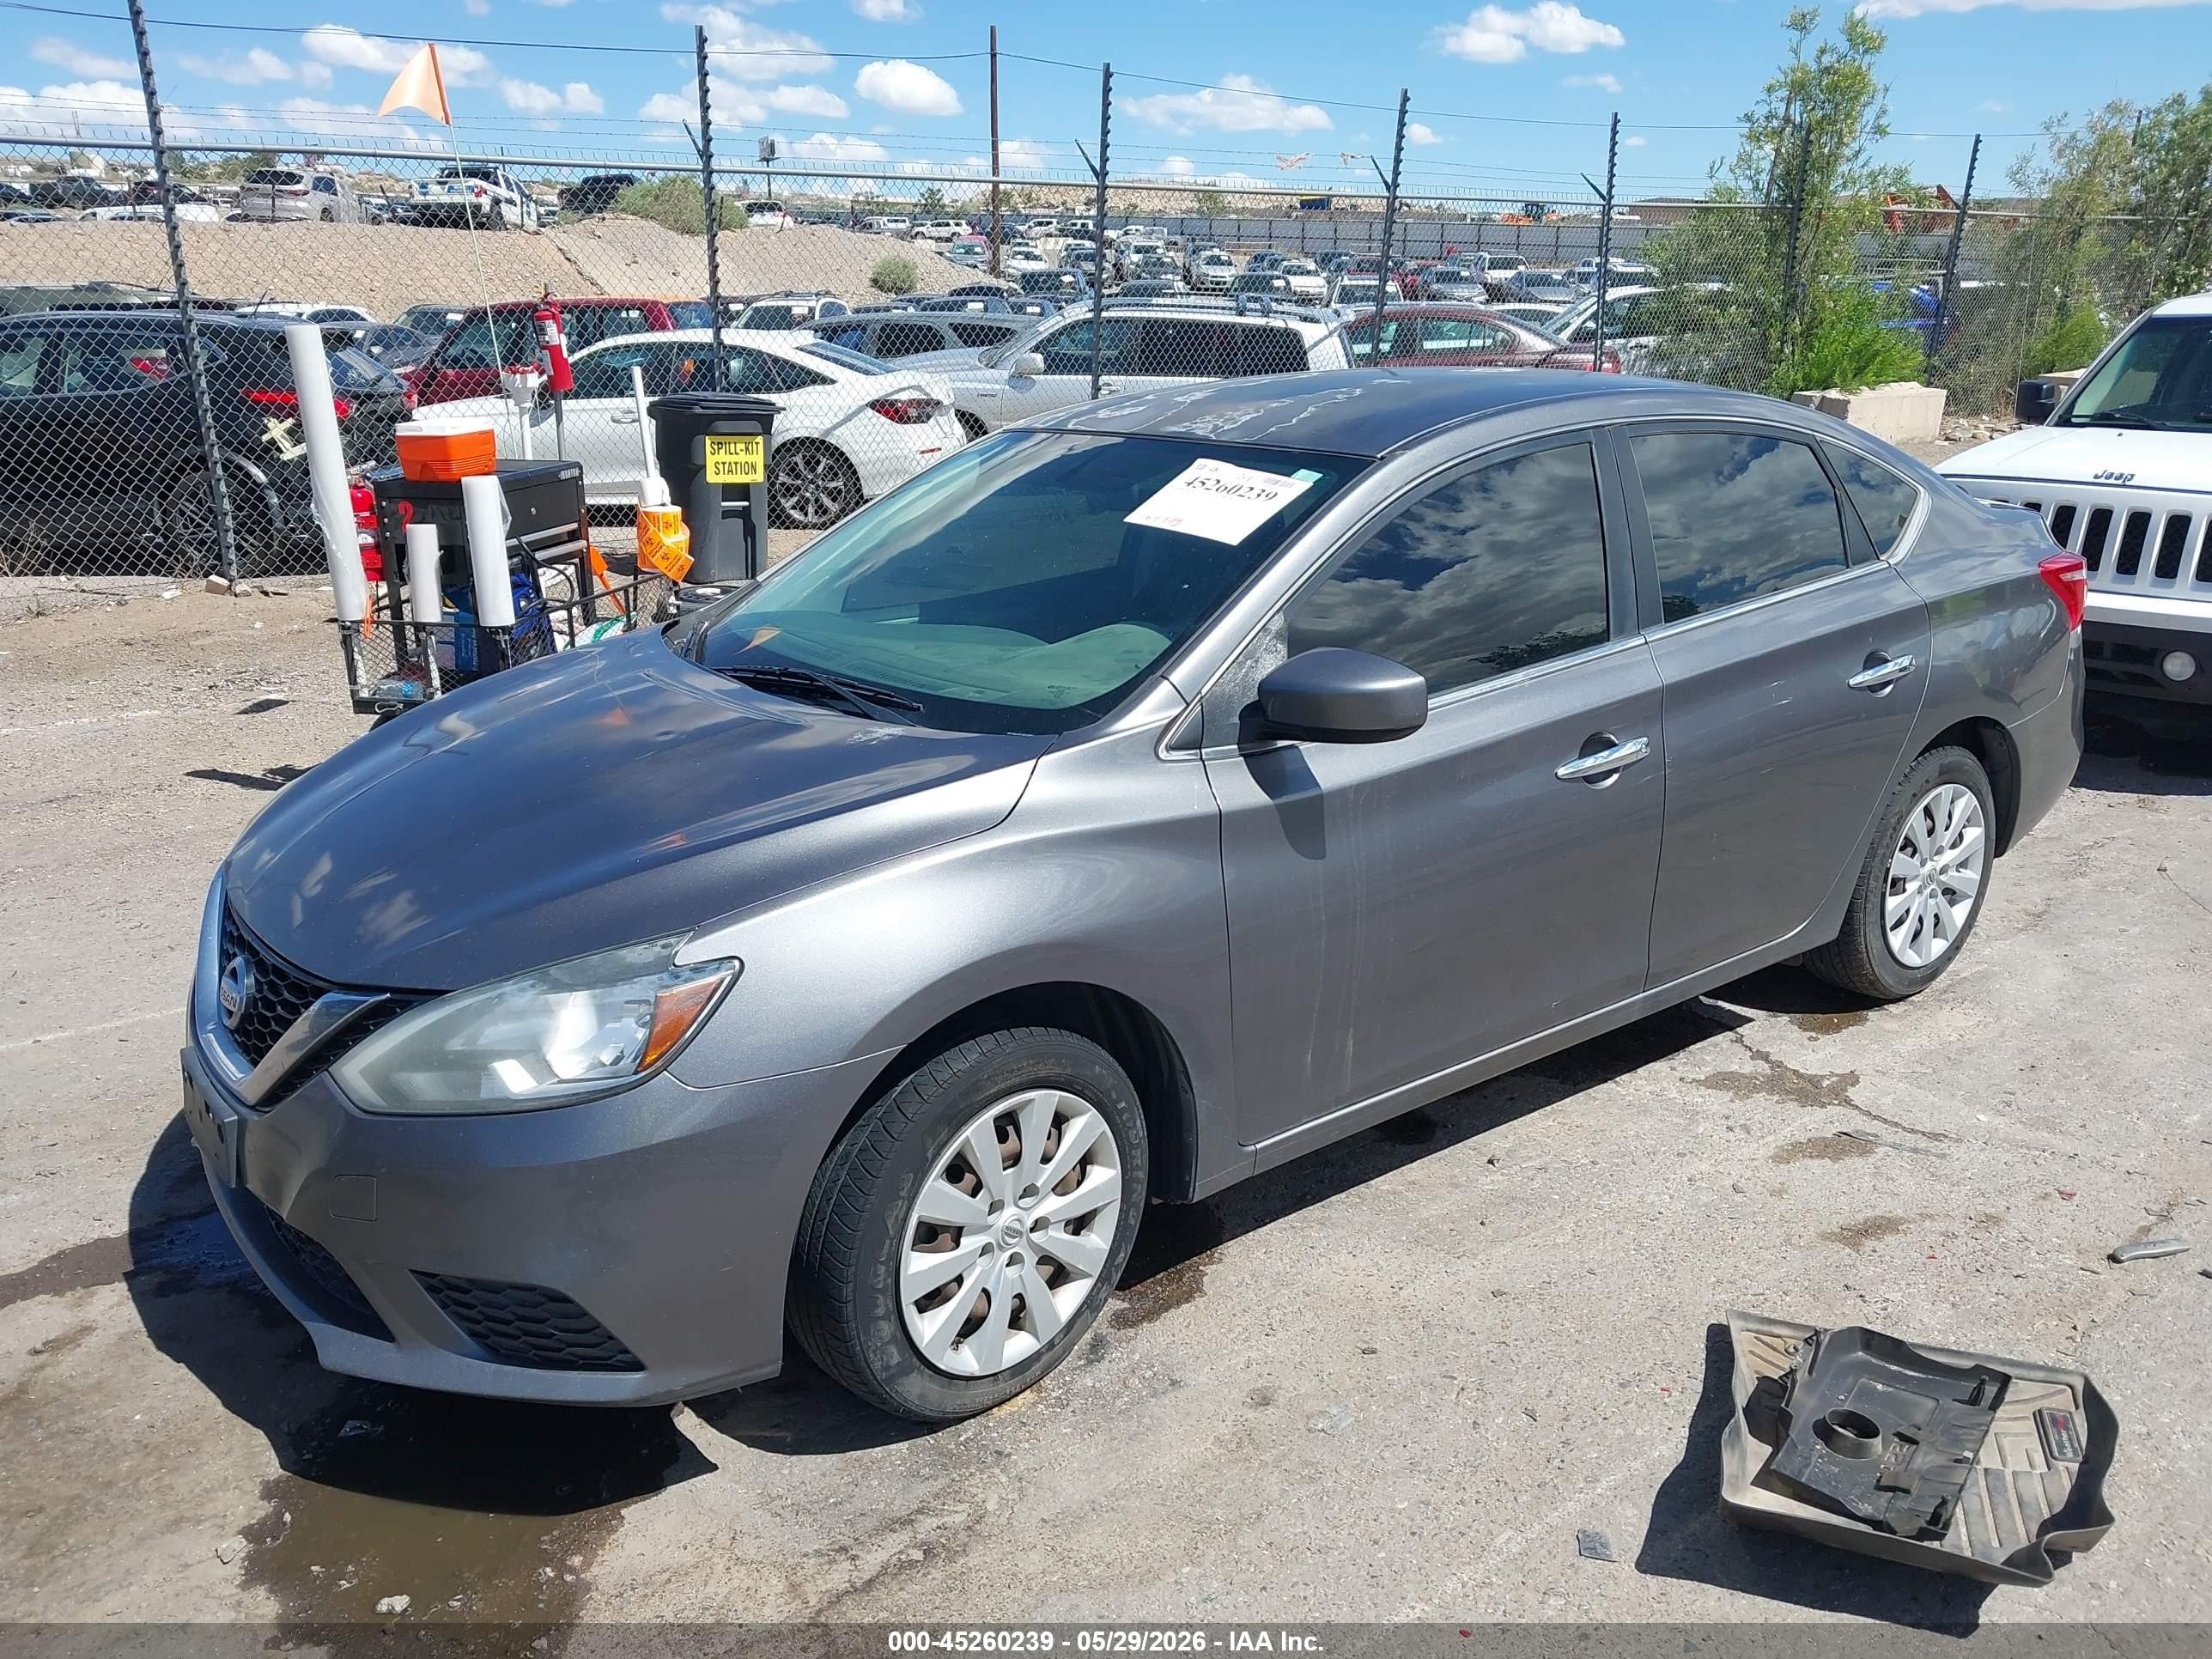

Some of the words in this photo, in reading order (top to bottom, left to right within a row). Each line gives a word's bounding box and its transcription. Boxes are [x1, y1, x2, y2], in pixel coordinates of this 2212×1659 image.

[709, 441, 761, 456] SPILL-KIT
[714, 461, 757, 476] STATION
[2093, 469, 2136, 483] Jeep
[1184, 476, 1279, 501] 45260239
